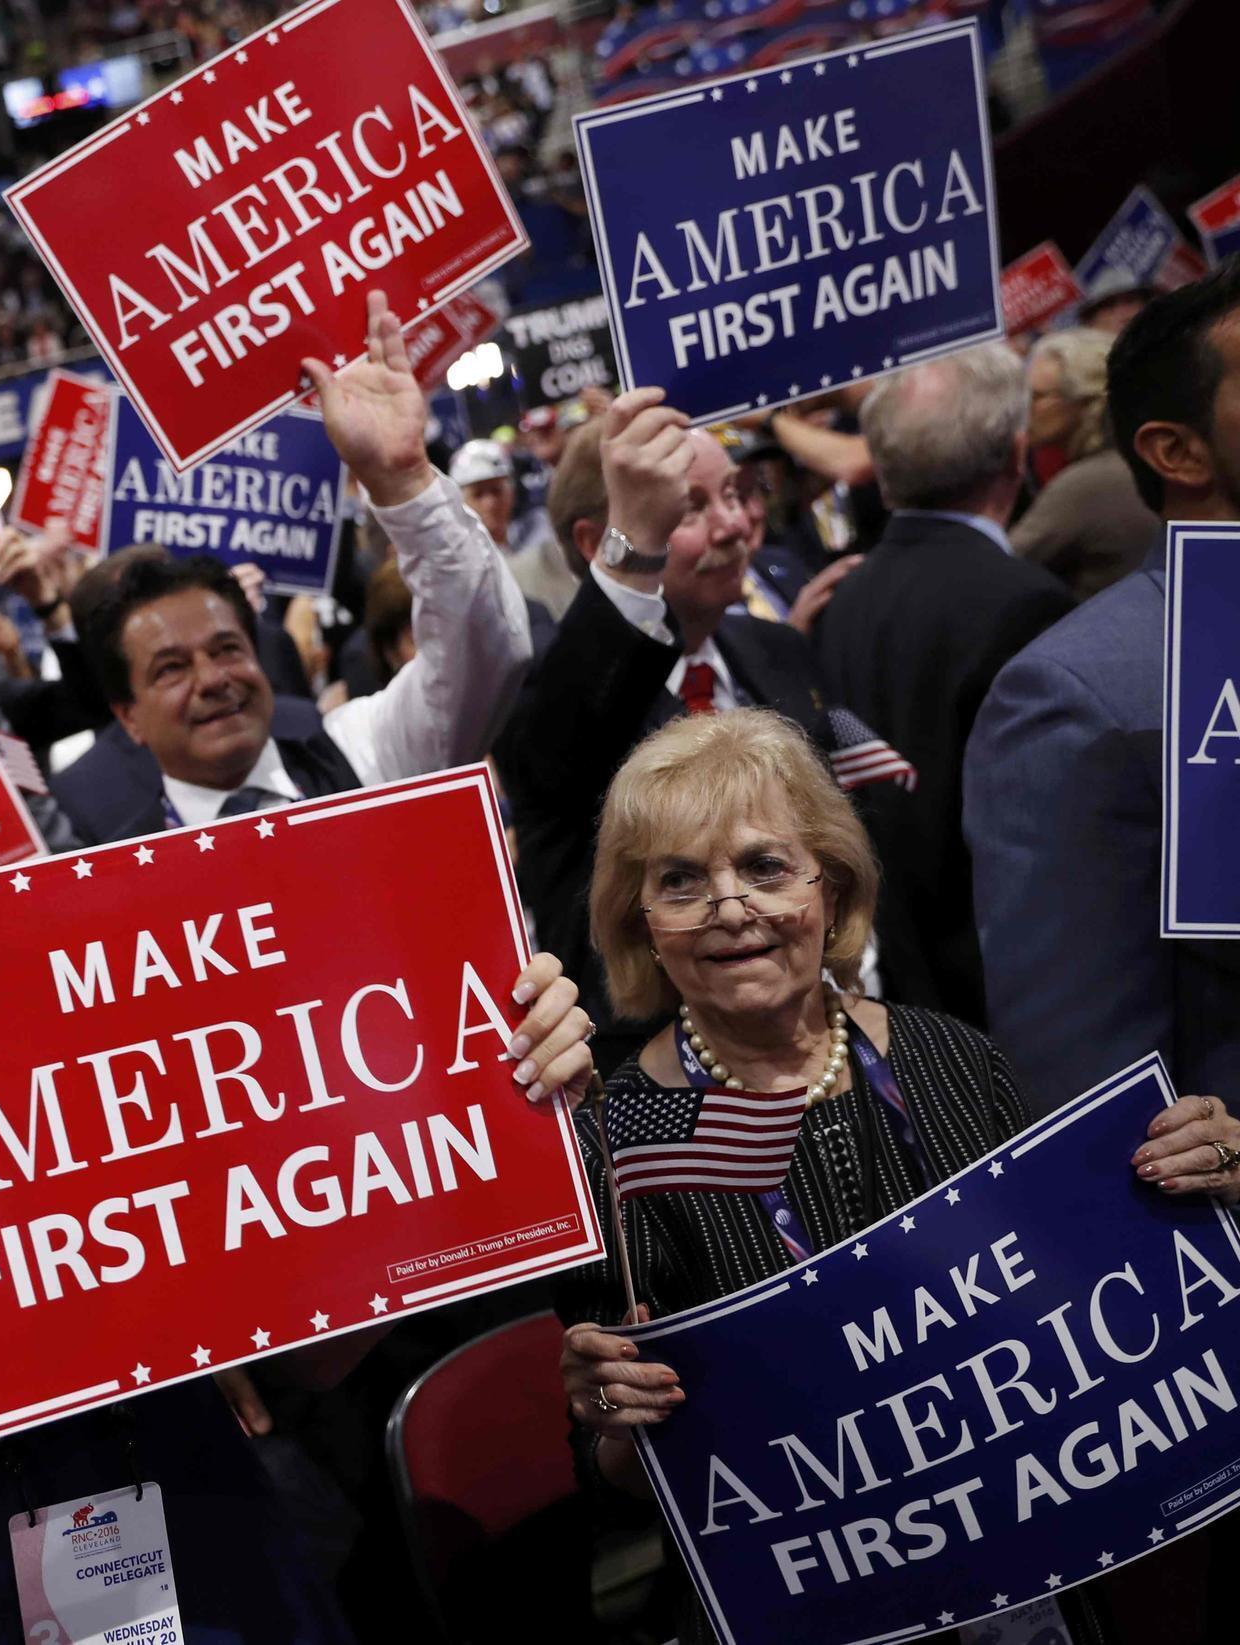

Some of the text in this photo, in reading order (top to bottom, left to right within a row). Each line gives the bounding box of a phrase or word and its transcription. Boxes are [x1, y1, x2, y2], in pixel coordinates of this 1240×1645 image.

[173, 81, 312, 188] MAKE
[730, 108, 860, 180] MAKE
[107, 84, 462, 351] AMERICA
[623, 148, 983, 310] AMERICA
[169, 261, 317, 388] FIRST
[321, 170, 464, 296] AGAIN
[668, 286, 800, 369] FIRST
[812, 240, 958, 330] AGAIN
[222, 431, 279, 461] AKE
[114, 455, 336, 525] AMERICA
[133, 509, 318, 561] FIRST AGAIN
[47, 901, 287, 1014] MAKE
[222, 1104, 498, 1250] AGAIN
[395, 1265, 415, 1276] Paid
[415, 1260, 427, 1271] for
[428, 1257, 439, 1268] by
[440, 1247, 470, 1264] Donald
[477, 1240, 504, 1254] Trump
[504, 1235, 516, 1246] for
[516, 1225, 557, 1243] President,
[557, 1221, 572, 1231] Inc.
[841, 1230, 1036, 1372] MAKE
[698, 1229, 1240, 1535] AMERICA
[770, 1349, 1238, 1595] FIRST AGAIN
[1167, 1496, 1184, 1509] Paid
[1183, 1491, 1194, 1502] for
[1193, 1487, 1203, 1496] by
[1202, 1471, 1227, 1490] Donald
[73, 1536, 121, 1552] CLEVELAND
[76, 1550, 164, 1580] CONNECTICUT
[104, 1562, 166, 1587] DELEGATE
[104, 1616, 174, 1643] WEDNESDAY
[161, 1631, 177, 1645] 20
